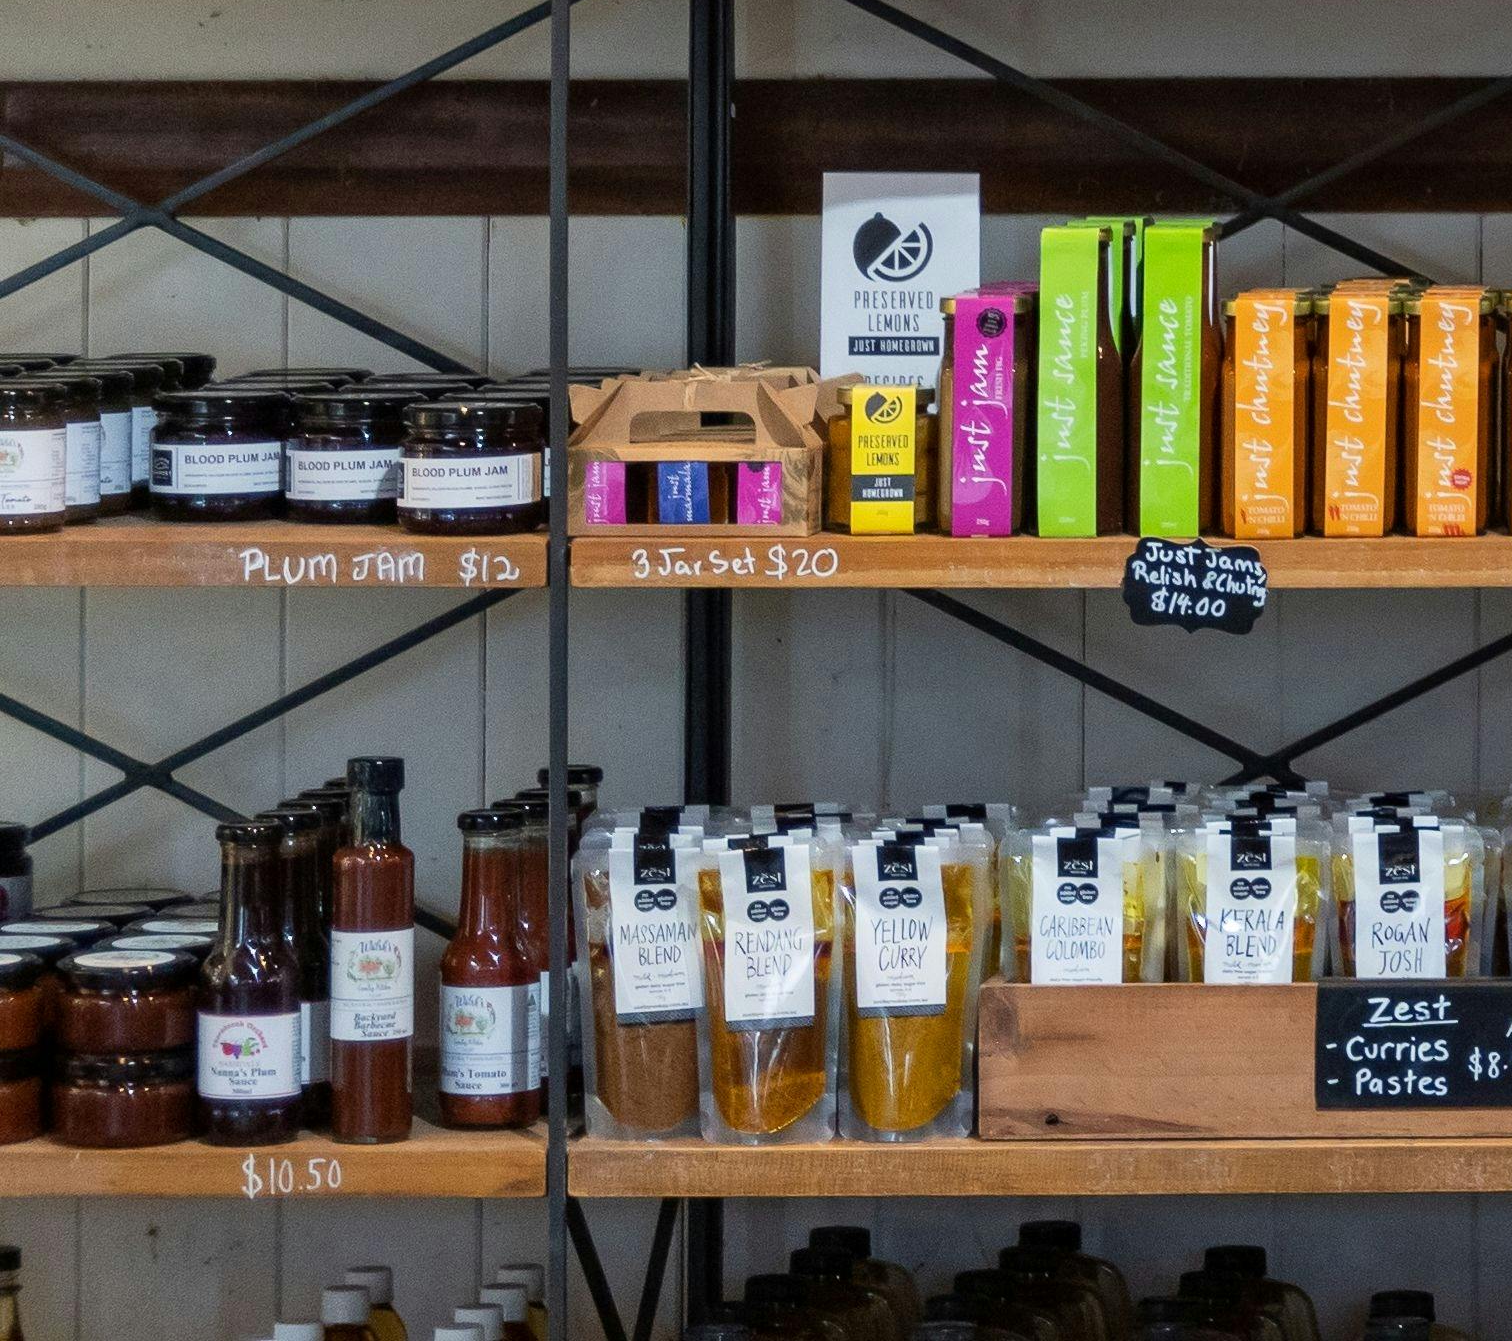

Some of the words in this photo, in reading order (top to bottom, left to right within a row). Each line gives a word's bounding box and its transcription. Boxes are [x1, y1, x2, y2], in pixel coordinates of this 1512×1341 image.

[854, 290, 933, 310] PRESERVED
[868, 313, 919, 333] LEMONS
[854, 339, 878, 352] JUST
[881, 339, 938, 353] HOMEGROWN
[961, 344, 1007, 419] jam
[858, 434, 908, 449] PRESERVED
[866, 451, 900, 466] LEMONS
[960, 420, 1007, 496] just
[412, 467, 444, 478] BLOOD
[449, 467, 481, 477] PLUM
[484, 466, 508, 476] JAM
[239, 548, 337, 583] PLUM
[353, 550, 424, 581] JAM
[459, 547, 519, 585] $12
[709, 550, 755, 574] Set
[766, 544, 839, 579] $20
[1132, 560, 1197, 588] Relish
[752, 871, 781, 886] zest
[872, 918, 931, 944] YELLOW
[1040, 916, 1113, 938] CARIBBEAN
[1219, 908, 1284, 932] KERALA
[1372, 919, 1429, 944] ROGAN
[620, 923, 697, 944] MASSAMAN
[734, 930, 802, 956] RENDANG
[638, 944, 681, 964] BLEND
[879, 944, 927, 971] CURRY
[1046, 938, 1106, 959] COLOMBO
[1226, 935, 1277, 958] BLEND
[747, 955, 792, 977] BLEND
[1379, 951, 1423, 974] JOSH
[354, 1013, 396, 1023] Backyard
[1369, 995, 1452, 1023] Zest
[1346, 1037, 1449, 1061] Curries
[1355, 1072, 1447, 1096] Pastes
[241, 1153, 341, 1198] $10.50
